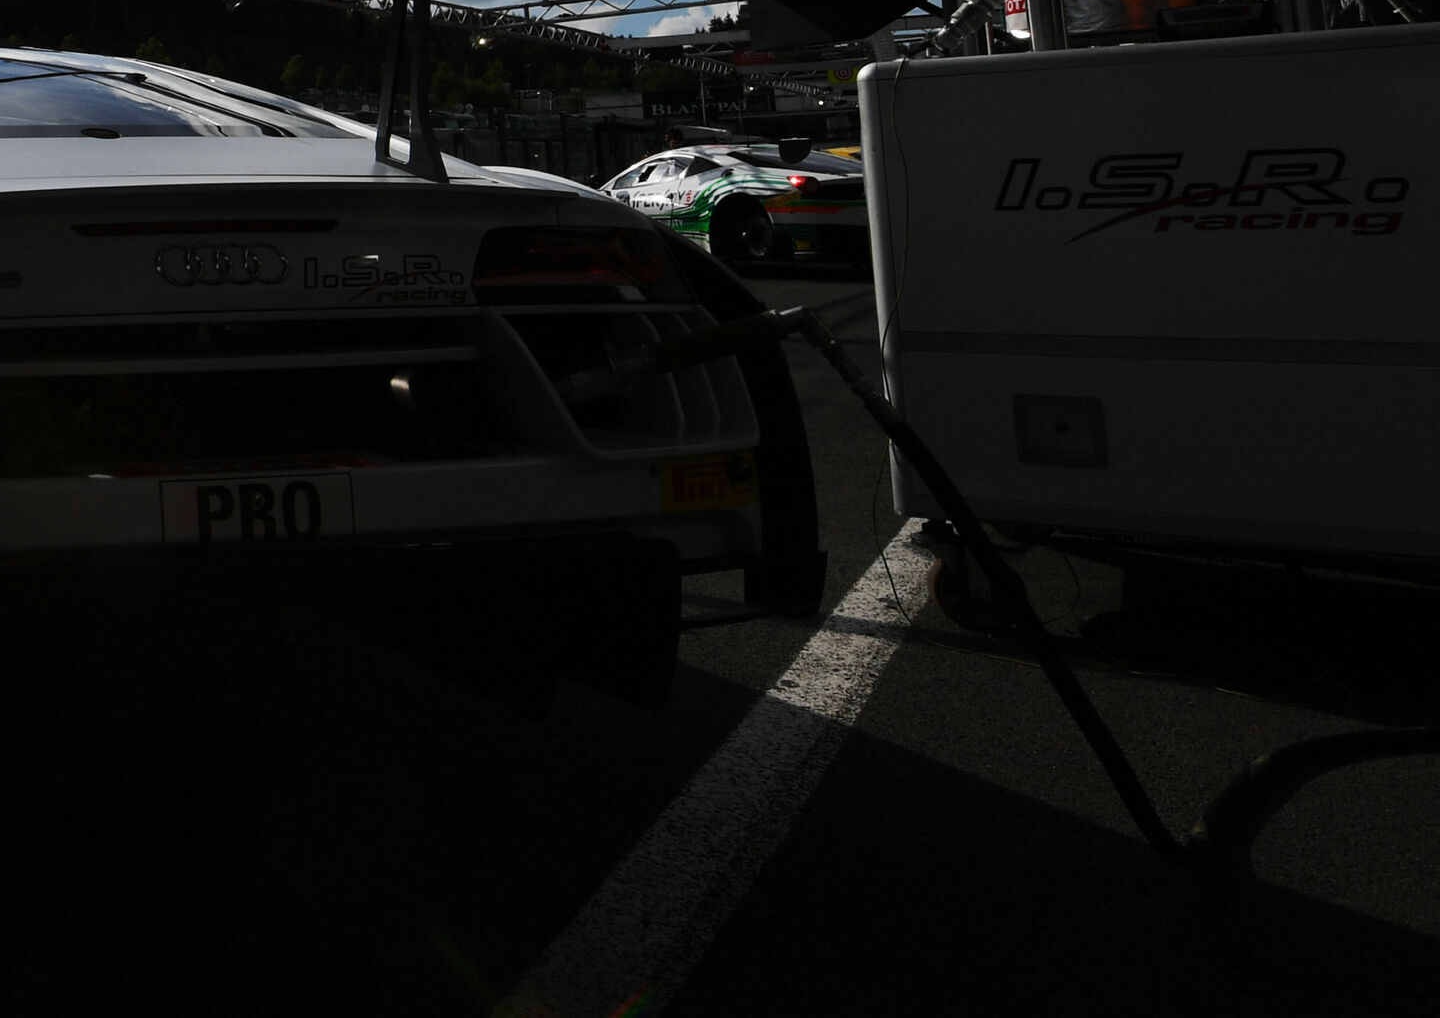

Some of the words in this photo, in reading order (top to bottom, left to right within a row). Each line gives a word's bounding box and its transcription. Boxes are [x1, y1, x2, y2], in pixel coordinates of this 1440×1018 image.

[1153, 207, 1403, 236] racing
[376, 286, 467, 304] racing
[196, 480, 322, 543] PRO
